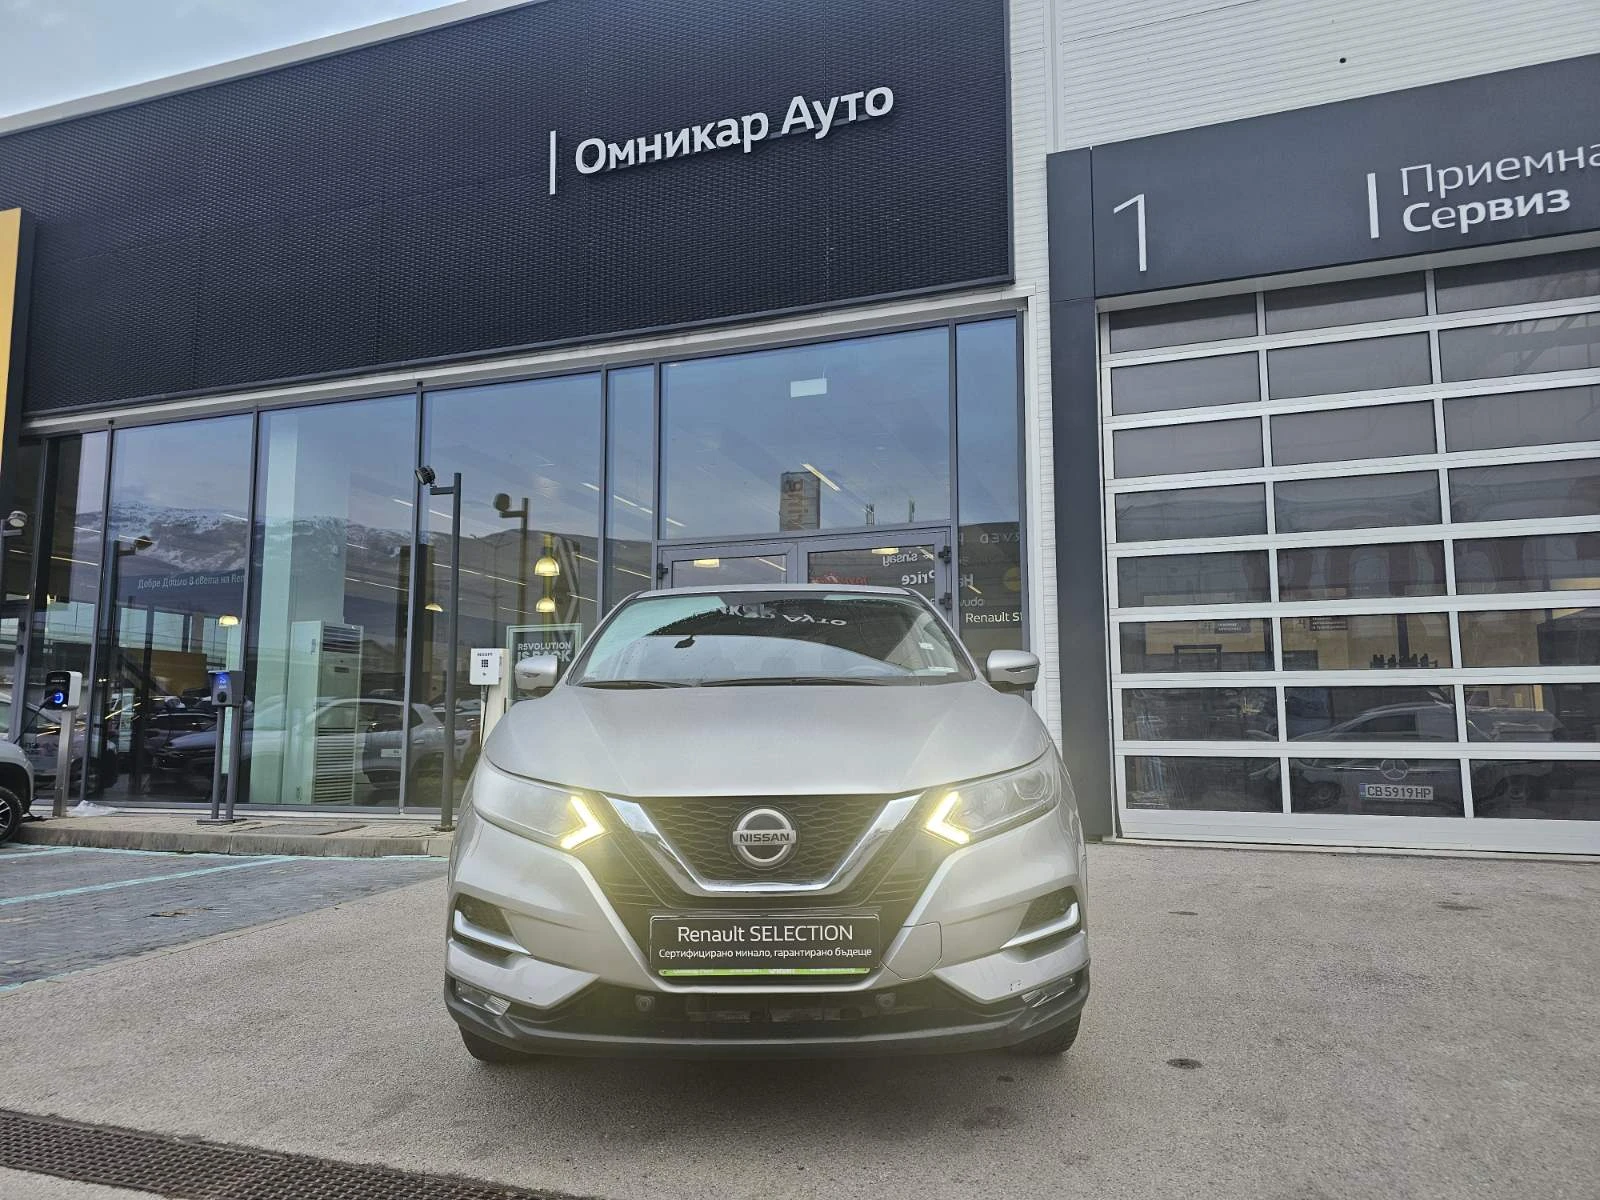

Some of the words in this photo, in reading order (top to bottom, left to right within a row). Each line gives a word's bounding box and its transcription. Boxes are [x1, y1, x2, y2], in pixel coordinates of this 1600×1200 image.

[574, 111, 769, 175] Омникар
[781, 86, 894, 140] Ауто
[1400, 143, 1600, 199] Приемна
[1402, 188, 1571, 235] Сервиз
[1113, 193, 1147, 272] 1
[137, 578, 161, 590] Добре
[965, 611, 1010, 624] Renault
[739, 832, 790, 842] NISSAN
[677, 925, 745, 943] Renault
[749, 924, 853, 942] SELECTION
[658, 947, 733, 960] Сертифицирано
[735, 948, 773, 959] минало,
[774, 948, 833, 959] гарантирано
[834, 946, 873, 958] бъдеще
